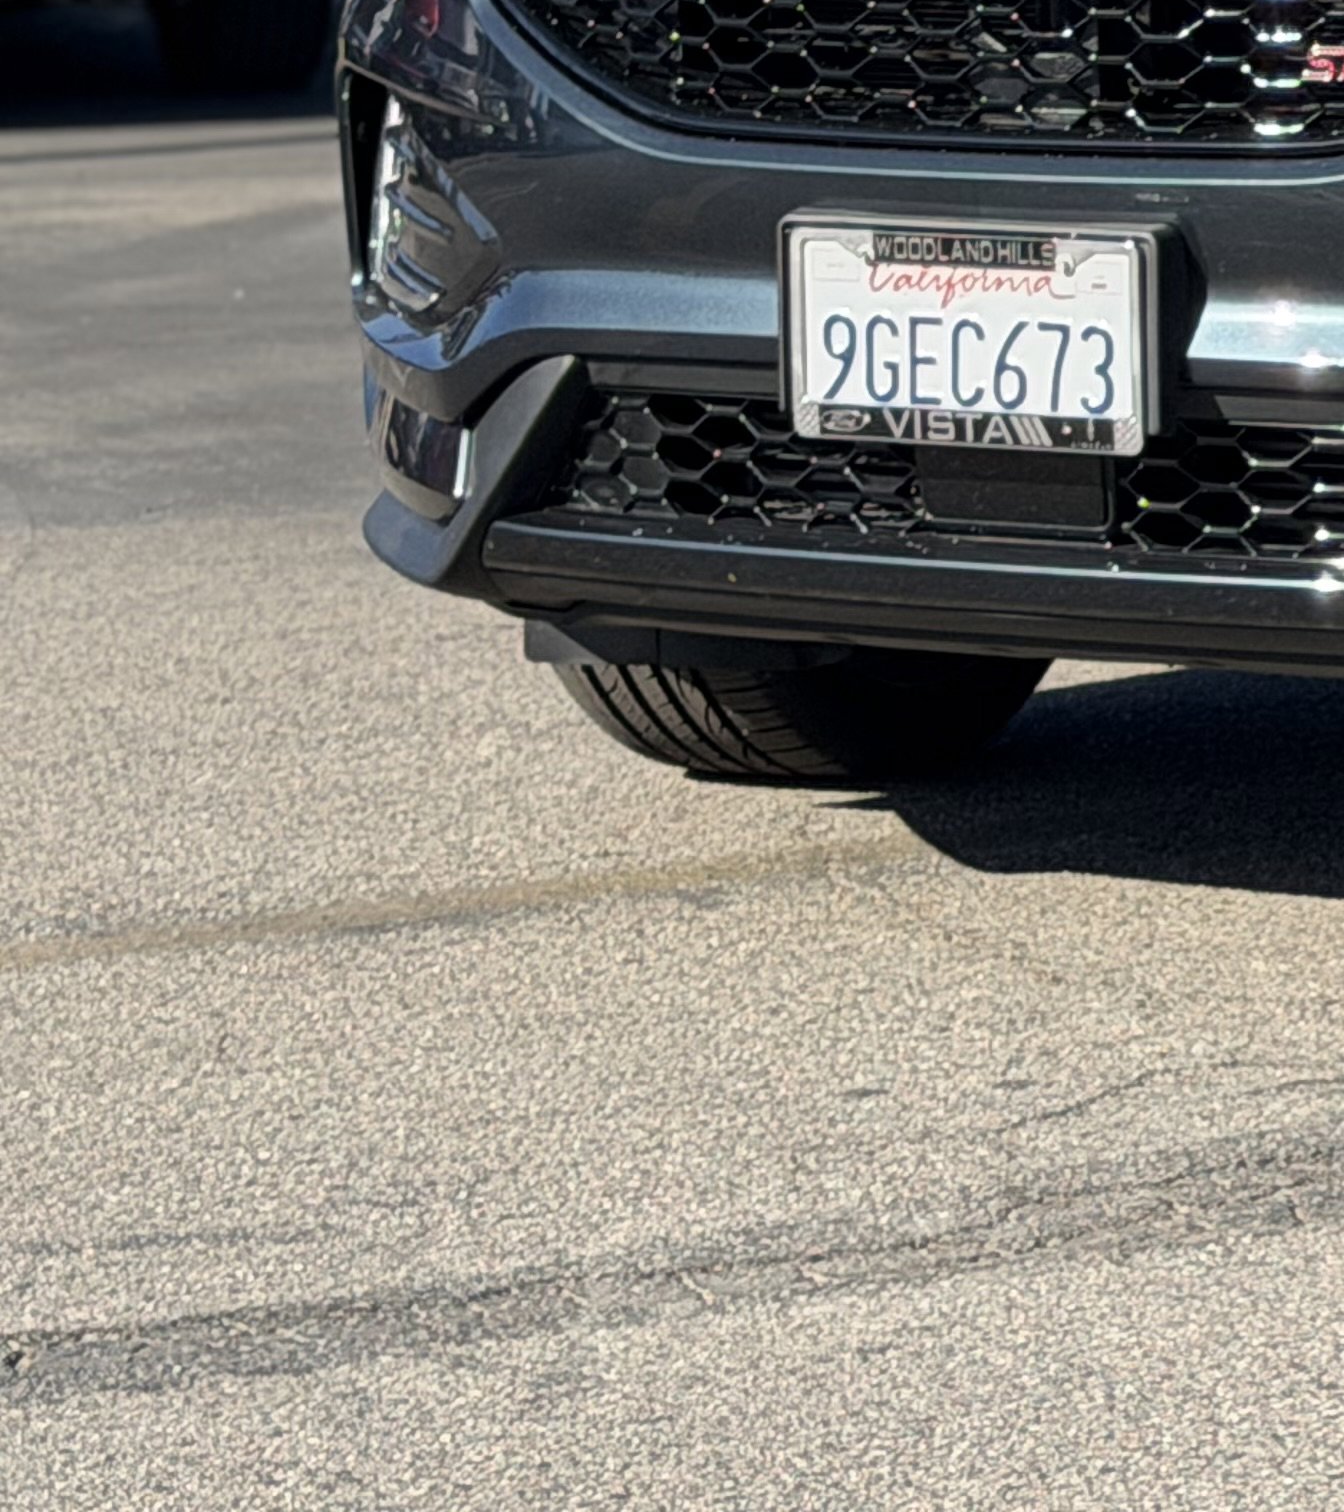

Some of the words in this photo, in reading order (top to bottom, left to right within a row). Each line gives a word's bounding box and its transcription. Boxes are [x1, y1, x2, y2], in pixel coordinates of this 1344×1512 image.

[874, 236, 994, 264] WOODLAND
[998, 240, 1055, 267] HILLS
[868, 262, 1076, 308] California
[823, 314, 1115, 415] 9GEC673
[882, 409, 1014, 445] VISTA
